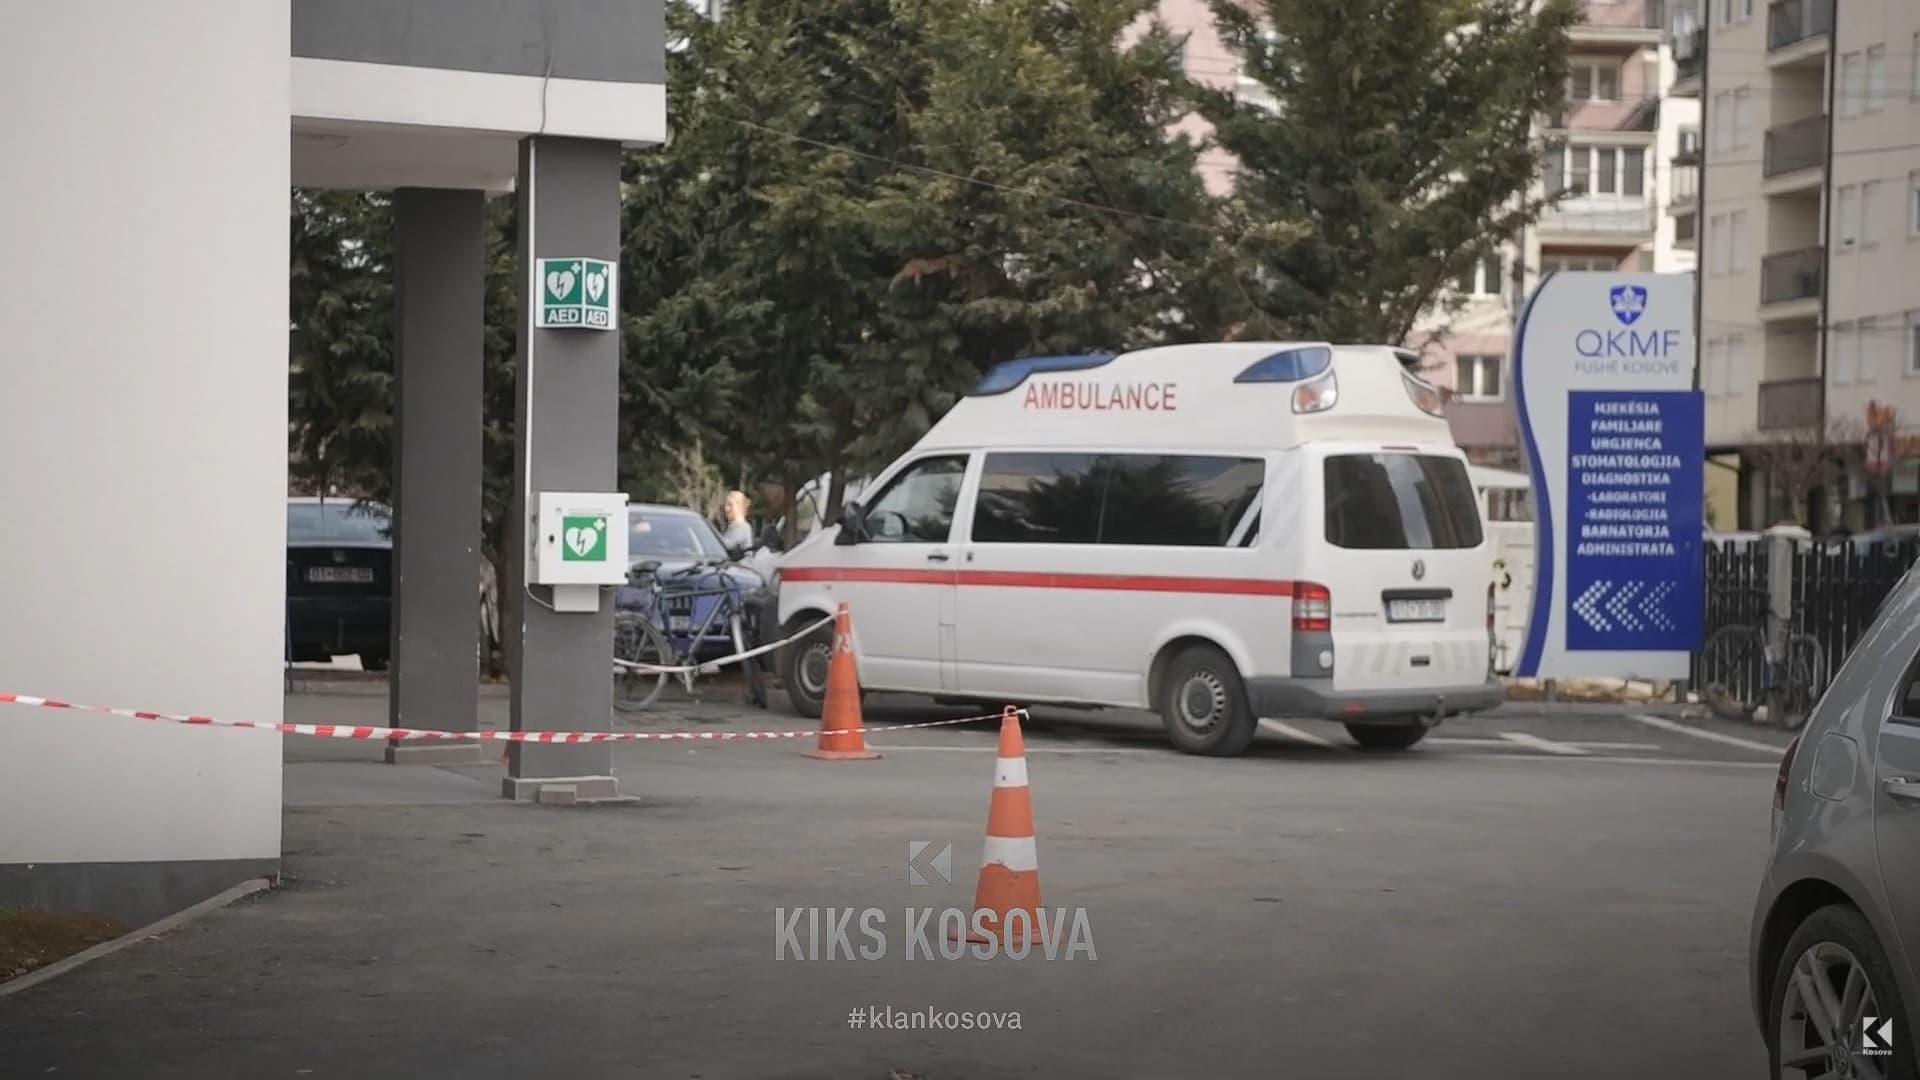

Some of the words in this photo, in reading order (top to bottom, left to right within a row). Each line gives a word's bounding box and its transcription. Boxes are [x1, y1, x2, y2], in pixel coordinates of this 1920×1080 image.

[548, 309, 579, 322] AED
[587, 310, 607, 325] AED
[1575, 329, 1680, 357] QKMF
[1023, 382, 1177, 411] AMBULANCE
[1591, 420, 1662, 433] FAMILJARE
[1591, 437, 1662, 450] URGJENCA
[1572, 454, 1681, 469] STOMATOLOGJIA
[1582, 472, 1670, 485] DIAGNOSTIKA
[1582, 525, 1670, 538] BARNATORJA
[1577, 542, 1675, 556] ADMINISTRATA
